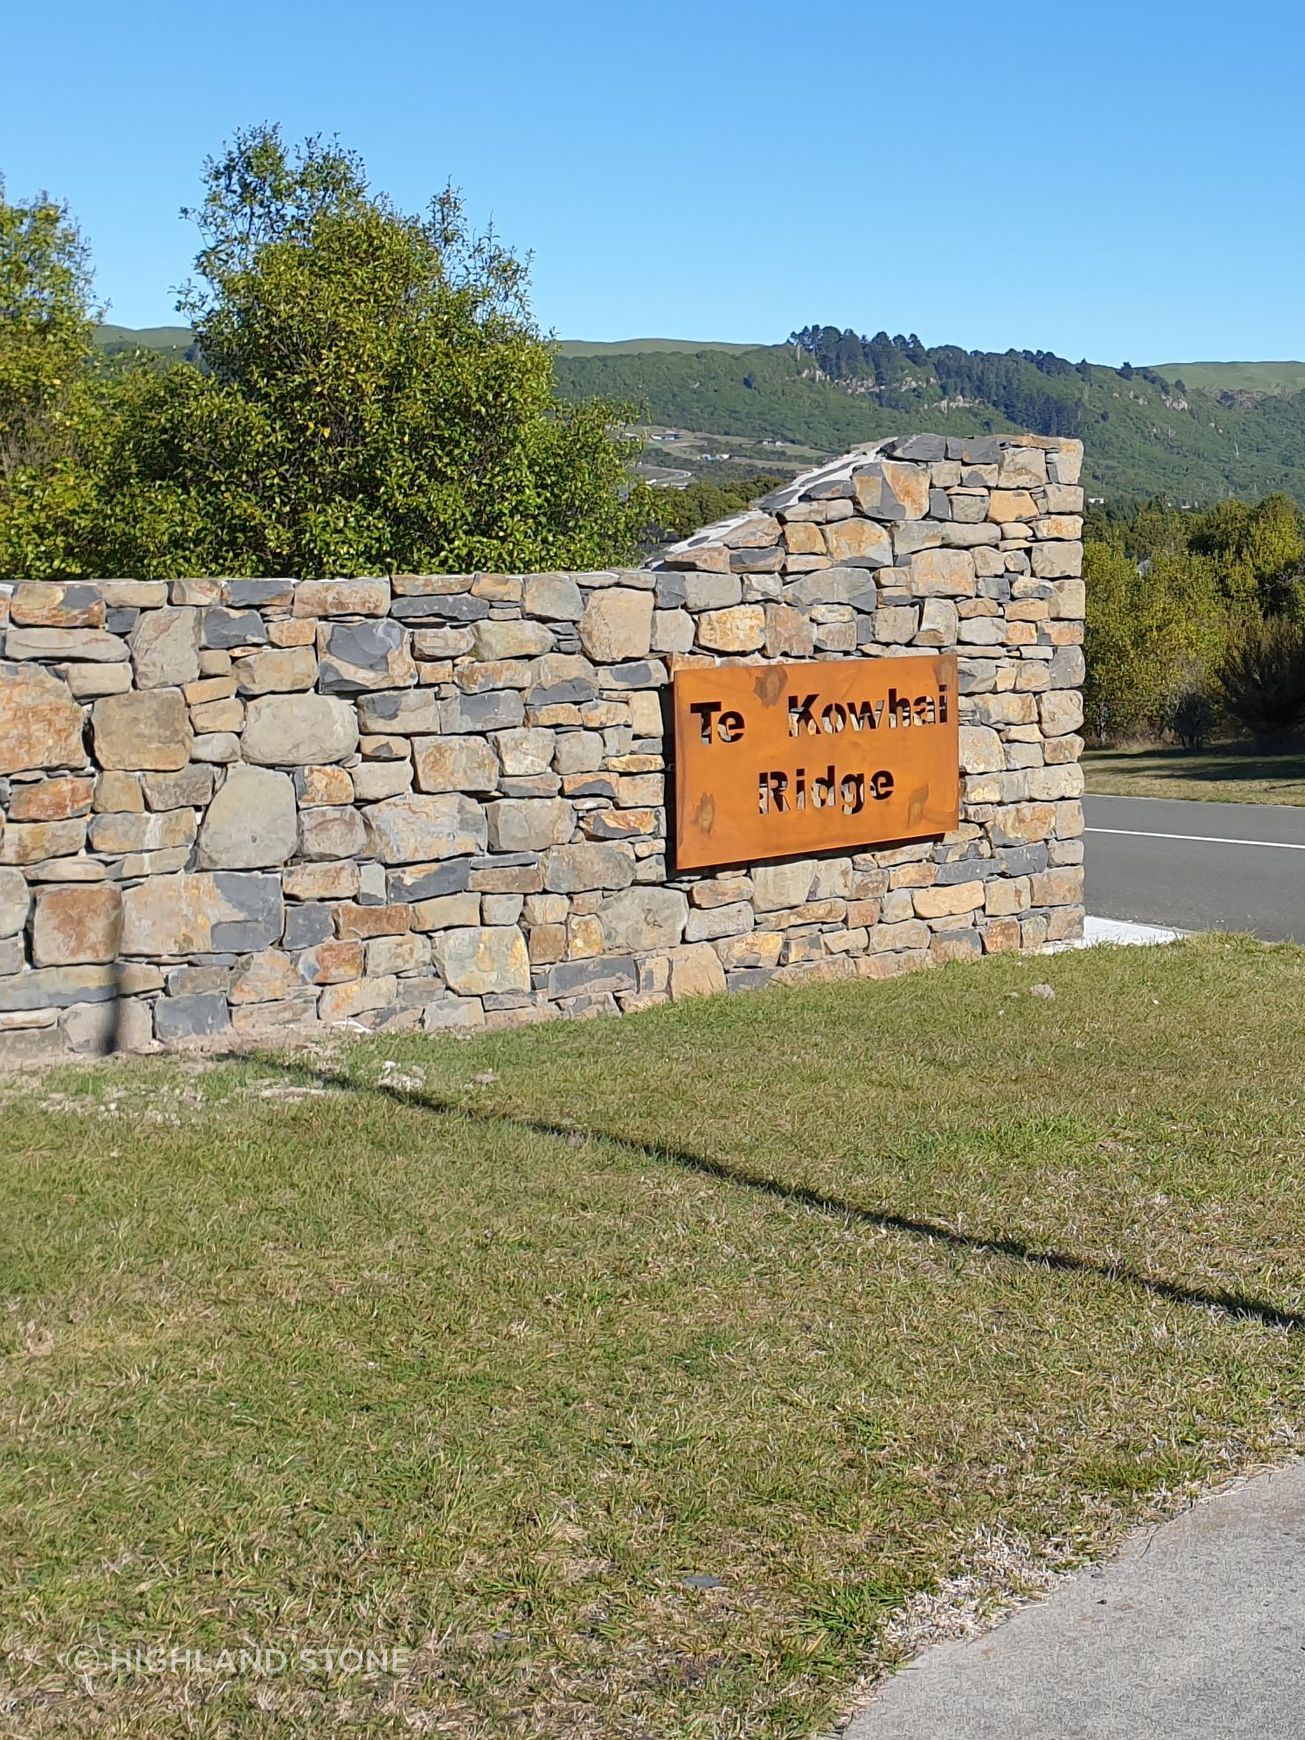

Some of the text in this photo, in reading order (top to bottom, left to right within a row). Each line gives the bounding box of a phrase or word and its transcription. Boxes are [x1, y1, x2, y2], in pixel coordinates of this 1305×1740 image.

[690, 684, 948, 744] Te Kowhai
[758, 765, 895, 815] Ridge
